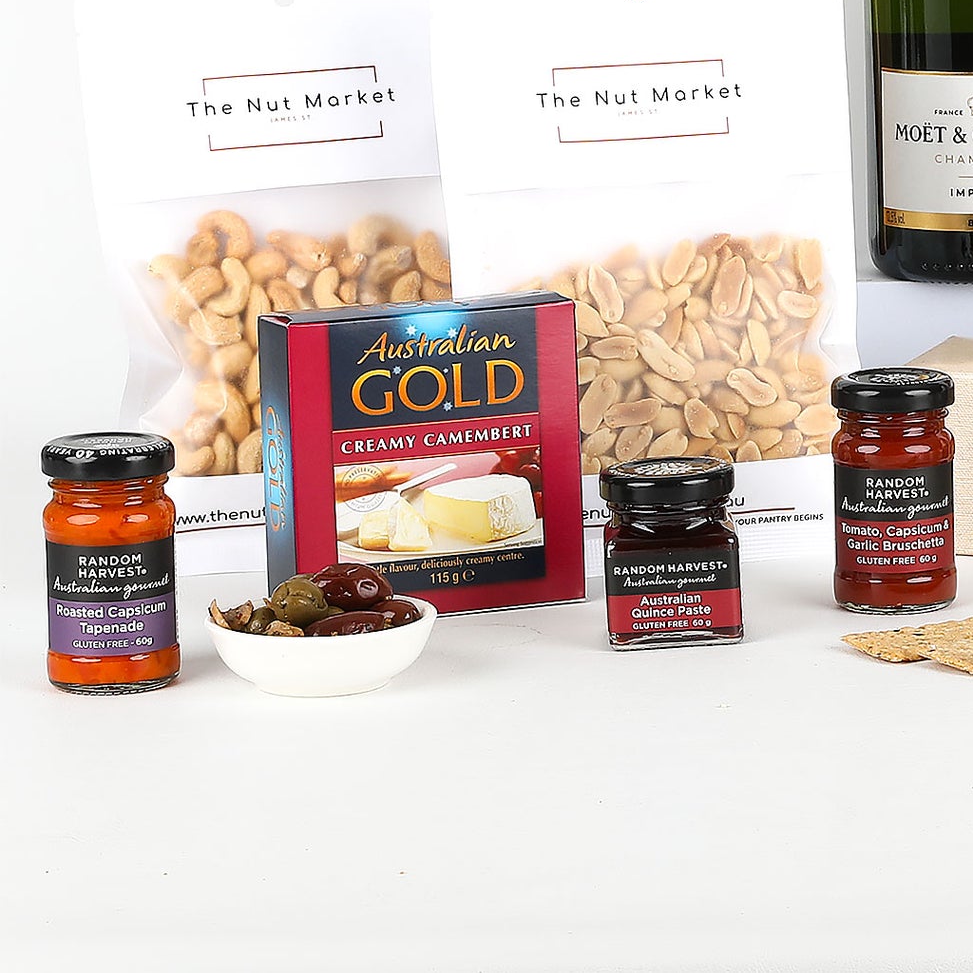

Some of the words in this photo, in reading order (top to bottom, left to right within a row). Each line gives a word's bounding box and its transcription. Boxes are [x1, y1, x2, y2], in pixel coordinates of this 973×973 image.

[186, 101, 233, 117] The
[247, 96, 291, 113] Nut
[305, 88, 396, 109] Market
[536, 93, 581, 108] The
[595, 90, 638, 106] Nut
[653, 84, 742, 103] Market
[895, 121, 947, 144] MOËT
[952, 128, 968, 144] &
[357, 324, 516, 365] Australian
[351, 359, 525, 416] GOLD
[340, 434, 417, 455] CREAMY
[423, 423, 533, 447] CAMEMBERT
[866, 476, 925, 488] RANDOM
[841, 496, 907, 513] Australian
[906, 495, 949, 519] gourmet
[758, 515, 792, 524] PANTRY
[794, 513, 824, 523] BEGINS
[841, 522, 884, 538] Tomato,
[886, 521, 943, 539] Capsicum
[943, 519, 950, 529] &
[847, 538, 880, 551] Garlic
[882, 536, 945, 552] Bruschetta
[78, 553, 143, 567] RANDOM
[389, 563, 420, 574] flavour,
[420, 557, 464, 571] deliciously
[465, 555, 496, 566] creamy
[497, 552, 525, 562] centre.
[856, 556, 891, 565] GLUTEN
[892, 556, 916, 565] FREE
[919, 555, 931, 564] 60
[613, 564, 665, 576] RANDOM
[53, 575, 124, 594] Australian
[123, 573, 170, 600] gourmet
[430, 572, 450, 584] 115
[452, 572, 460, 585] g
[623, 575, 676, 588] Australian
[675, 573, 717, 589] gourmet
[639, 593, 702, 606] Australian
[56, 603, 104, 619] Roasted
[107, 600, 167, 620] Capsicum
[631, 605, 675, 619] Quince
[677, 604, 712, 616] Paste
[79, 620, 144, 636] Tapenade
[632, 621, 666, 630] GLUTEN
[667, 619, 689, 628] FREE
[692, 619, 704, 627] 60
[72, 639, 105, 649] GLUTEN
[106, 639, 129, 648] FREE
[136, 636, 153, 647] 60g
